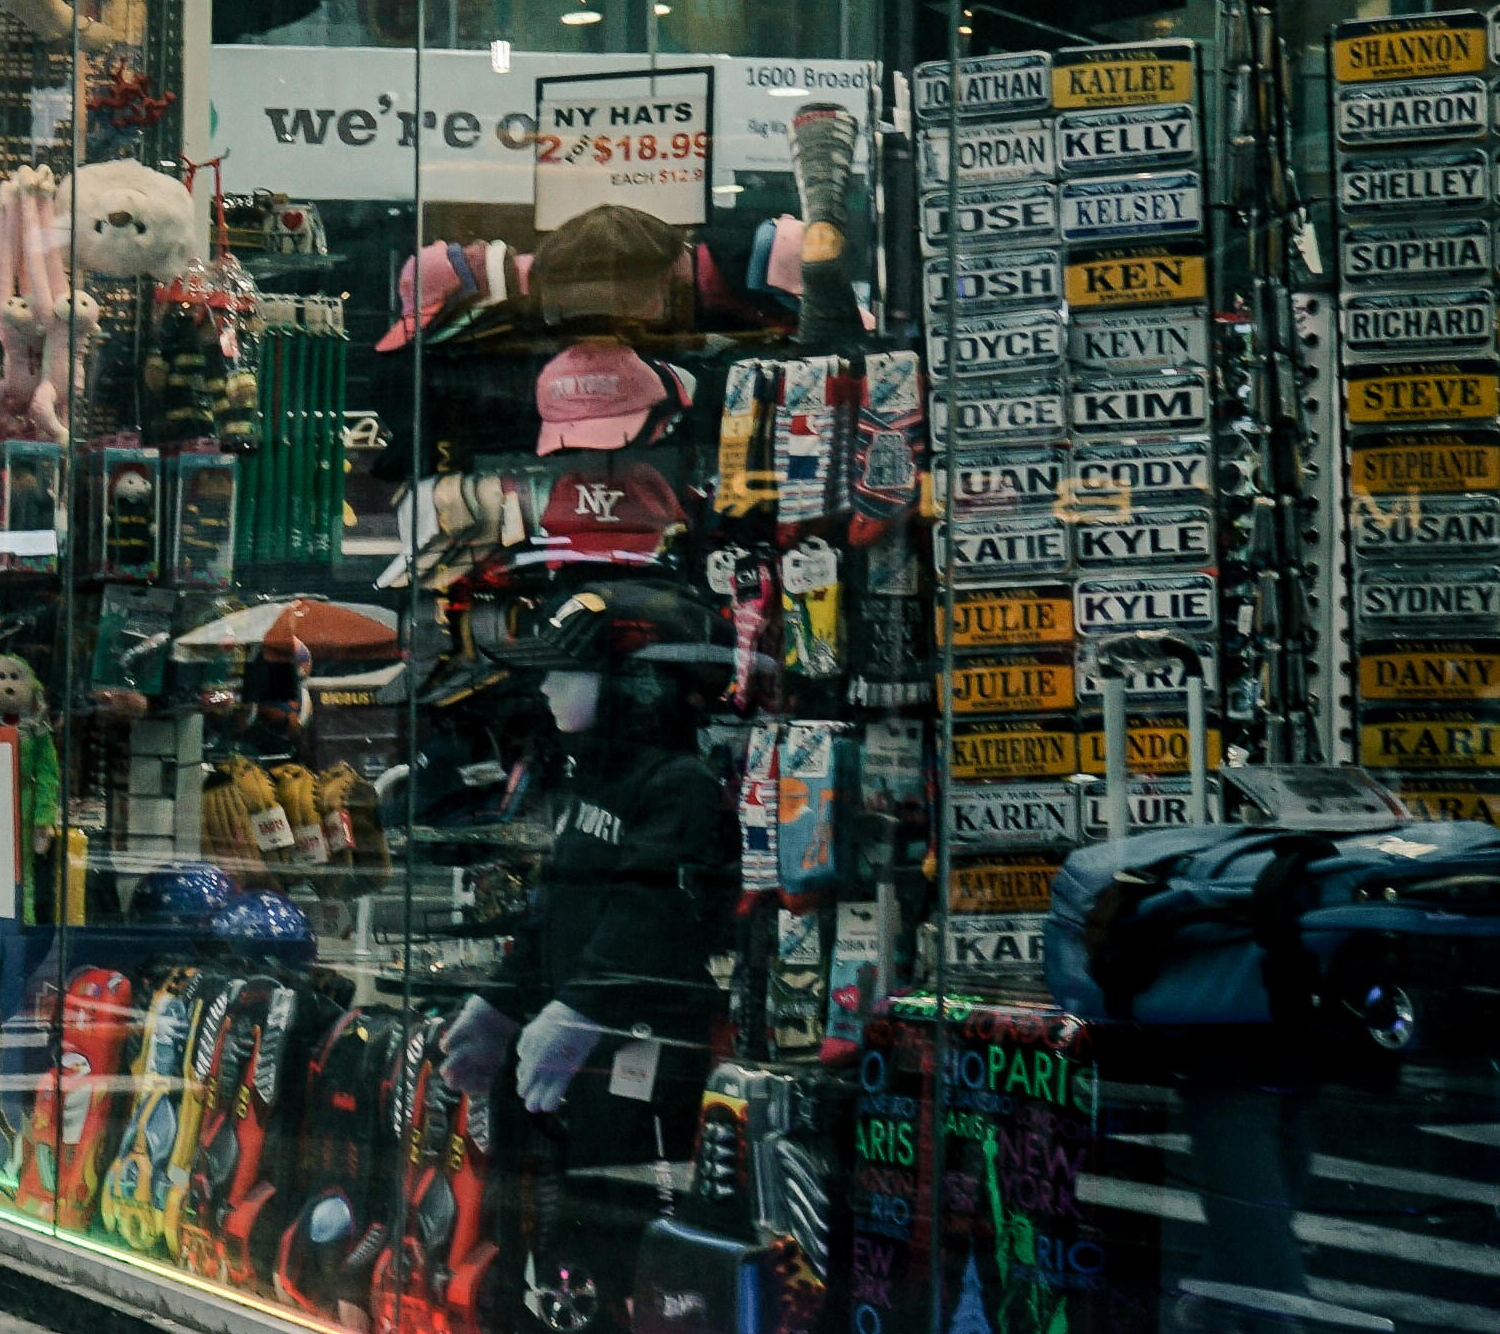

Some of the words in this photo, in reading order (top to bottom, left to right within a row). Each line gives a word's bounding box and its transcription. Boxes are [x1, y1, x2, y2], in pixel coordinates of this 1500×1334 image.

[1350, 32, 1471, 70] SHANNON
[746, 67, 797, 88] 1600
[1069, 63, 1176, 96] KAYLEE
[555, 107, 598, 128] NY
[609, 102, 693, 126] HATS
[1345, 96, 1478, 130] SHARON
[956, 136, 1045, 169] ORDAN
[1065, 123, 1187, 157] KELLY
[610, 170, 655, 187] EACH
[1349, 167, 1482, 203] SHELLEY
[1075, 192, 1186, 228] KELSEY
[1351, 238, 1483, 273] SOPHIA
[1084, 260, 1184, 293] KEN
[1352, 307, 1485, 340] RICHARD
[1083, 326, 1193, 360] KEVIN
[1085, 390, 1193, 422] KIM
[1363, 378, 1484, 412] STEVE
[956, 400, 1056, 430] OYCE
[1364, 447, 1489, 482] STEPHANIE
[575, 483, 624, 523] NY
[1082, 525, 1208, 557] KYLE
[1362, 514, 1496, 546] SUSAN
[1084, 591, 1208, 622] KYLIE
[1364, 585, 1491, 615] SYDNEY
[954, 601, 1056, 635] JULIE
[954, 668, 1057, 701] JULIE
[1375, 659, 1496, 688] DANNY
[952, 734, 1066, 766] KATHERYN
[953, 802, 1068, 833] KAREN
